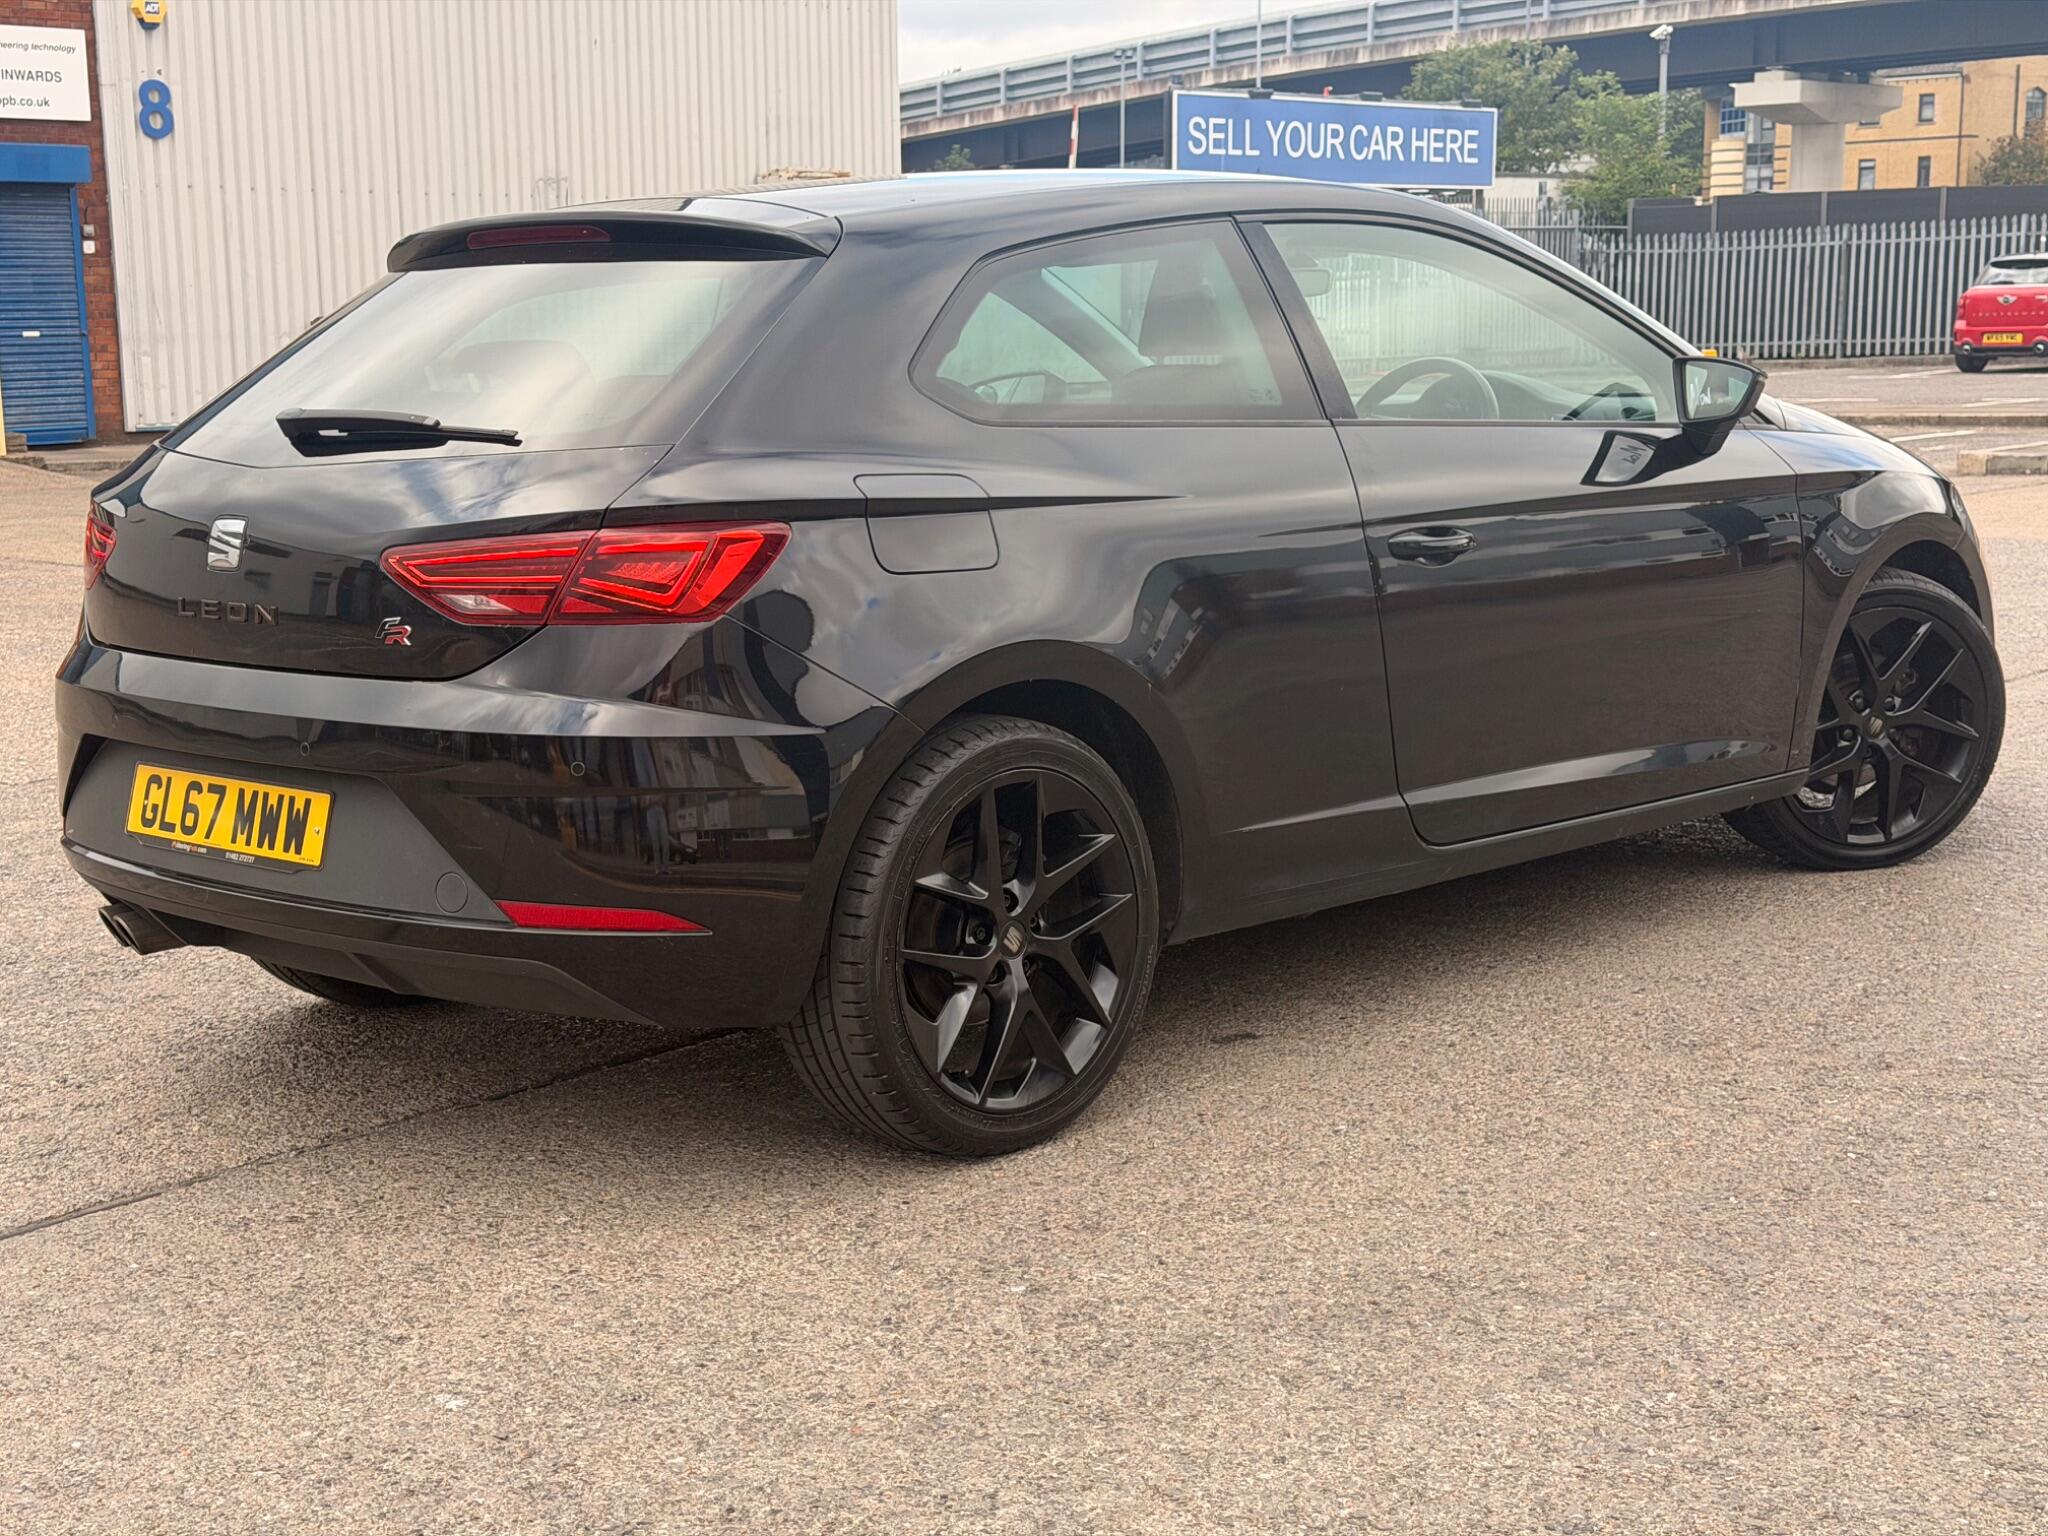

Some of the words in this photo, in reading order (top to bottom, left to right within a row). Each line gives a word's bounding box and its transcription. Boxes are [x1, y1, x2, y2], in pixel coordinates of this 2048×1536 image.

[31, 42, 76, 54] technology
[1, 68, 63, 83] INWARDS
[0, 95, 50, 108] pb.co.uk
[138, 79, 175, 139] 8
[1187, 116, 1260, 156] SELL
[1266, 120, 1345, 160] YOUR
[1349, 124, 1405, 162] CAR
[1411, 127, 1479, 165] HERE
[177, 597, 279, 626] LEON
[375, 616, 412, 646] FR
[140, 773, 227, 840] GL67
[230, 787, 312, 856] MWW
